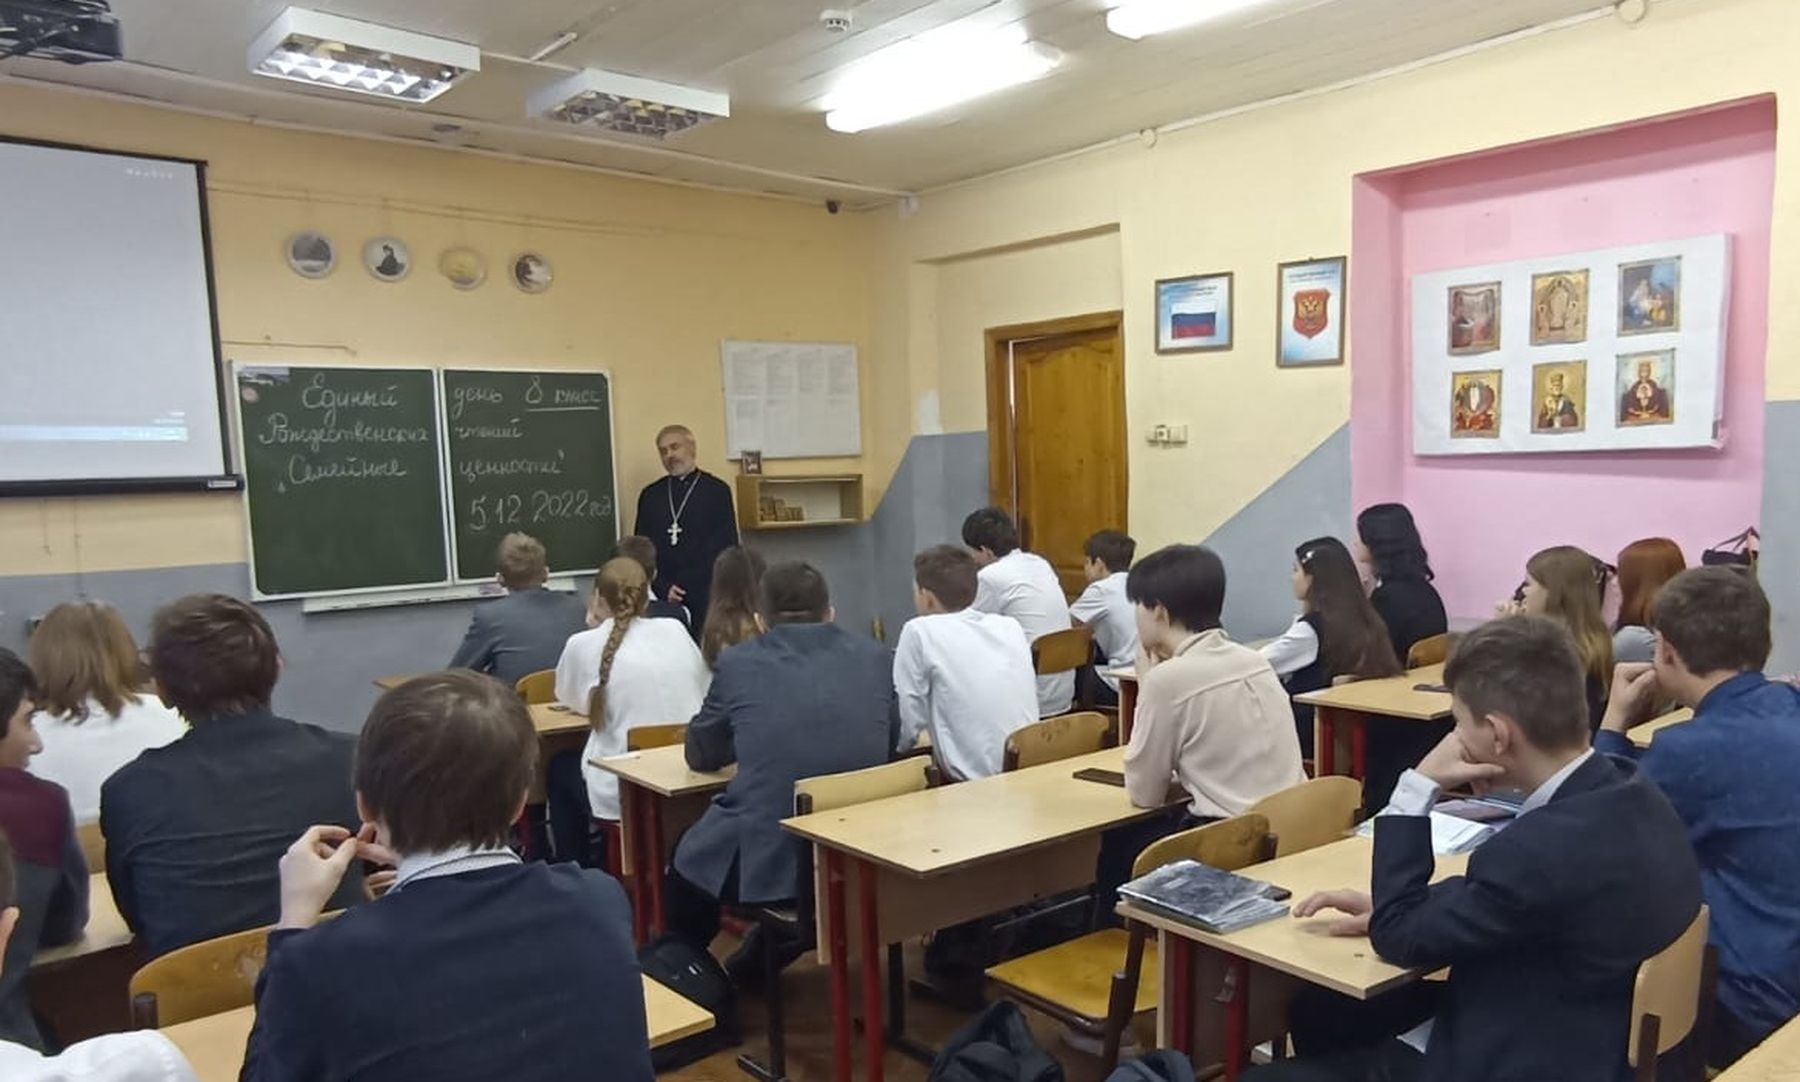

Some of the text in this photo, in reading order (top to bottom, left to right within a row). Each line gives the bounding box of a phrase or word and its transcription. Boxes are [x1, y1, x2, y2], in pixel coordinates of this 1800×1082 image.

[302, 373, 399, 426] Единый
[452, 385, 504, 420] день
[525, 374, 544, 404] 8
